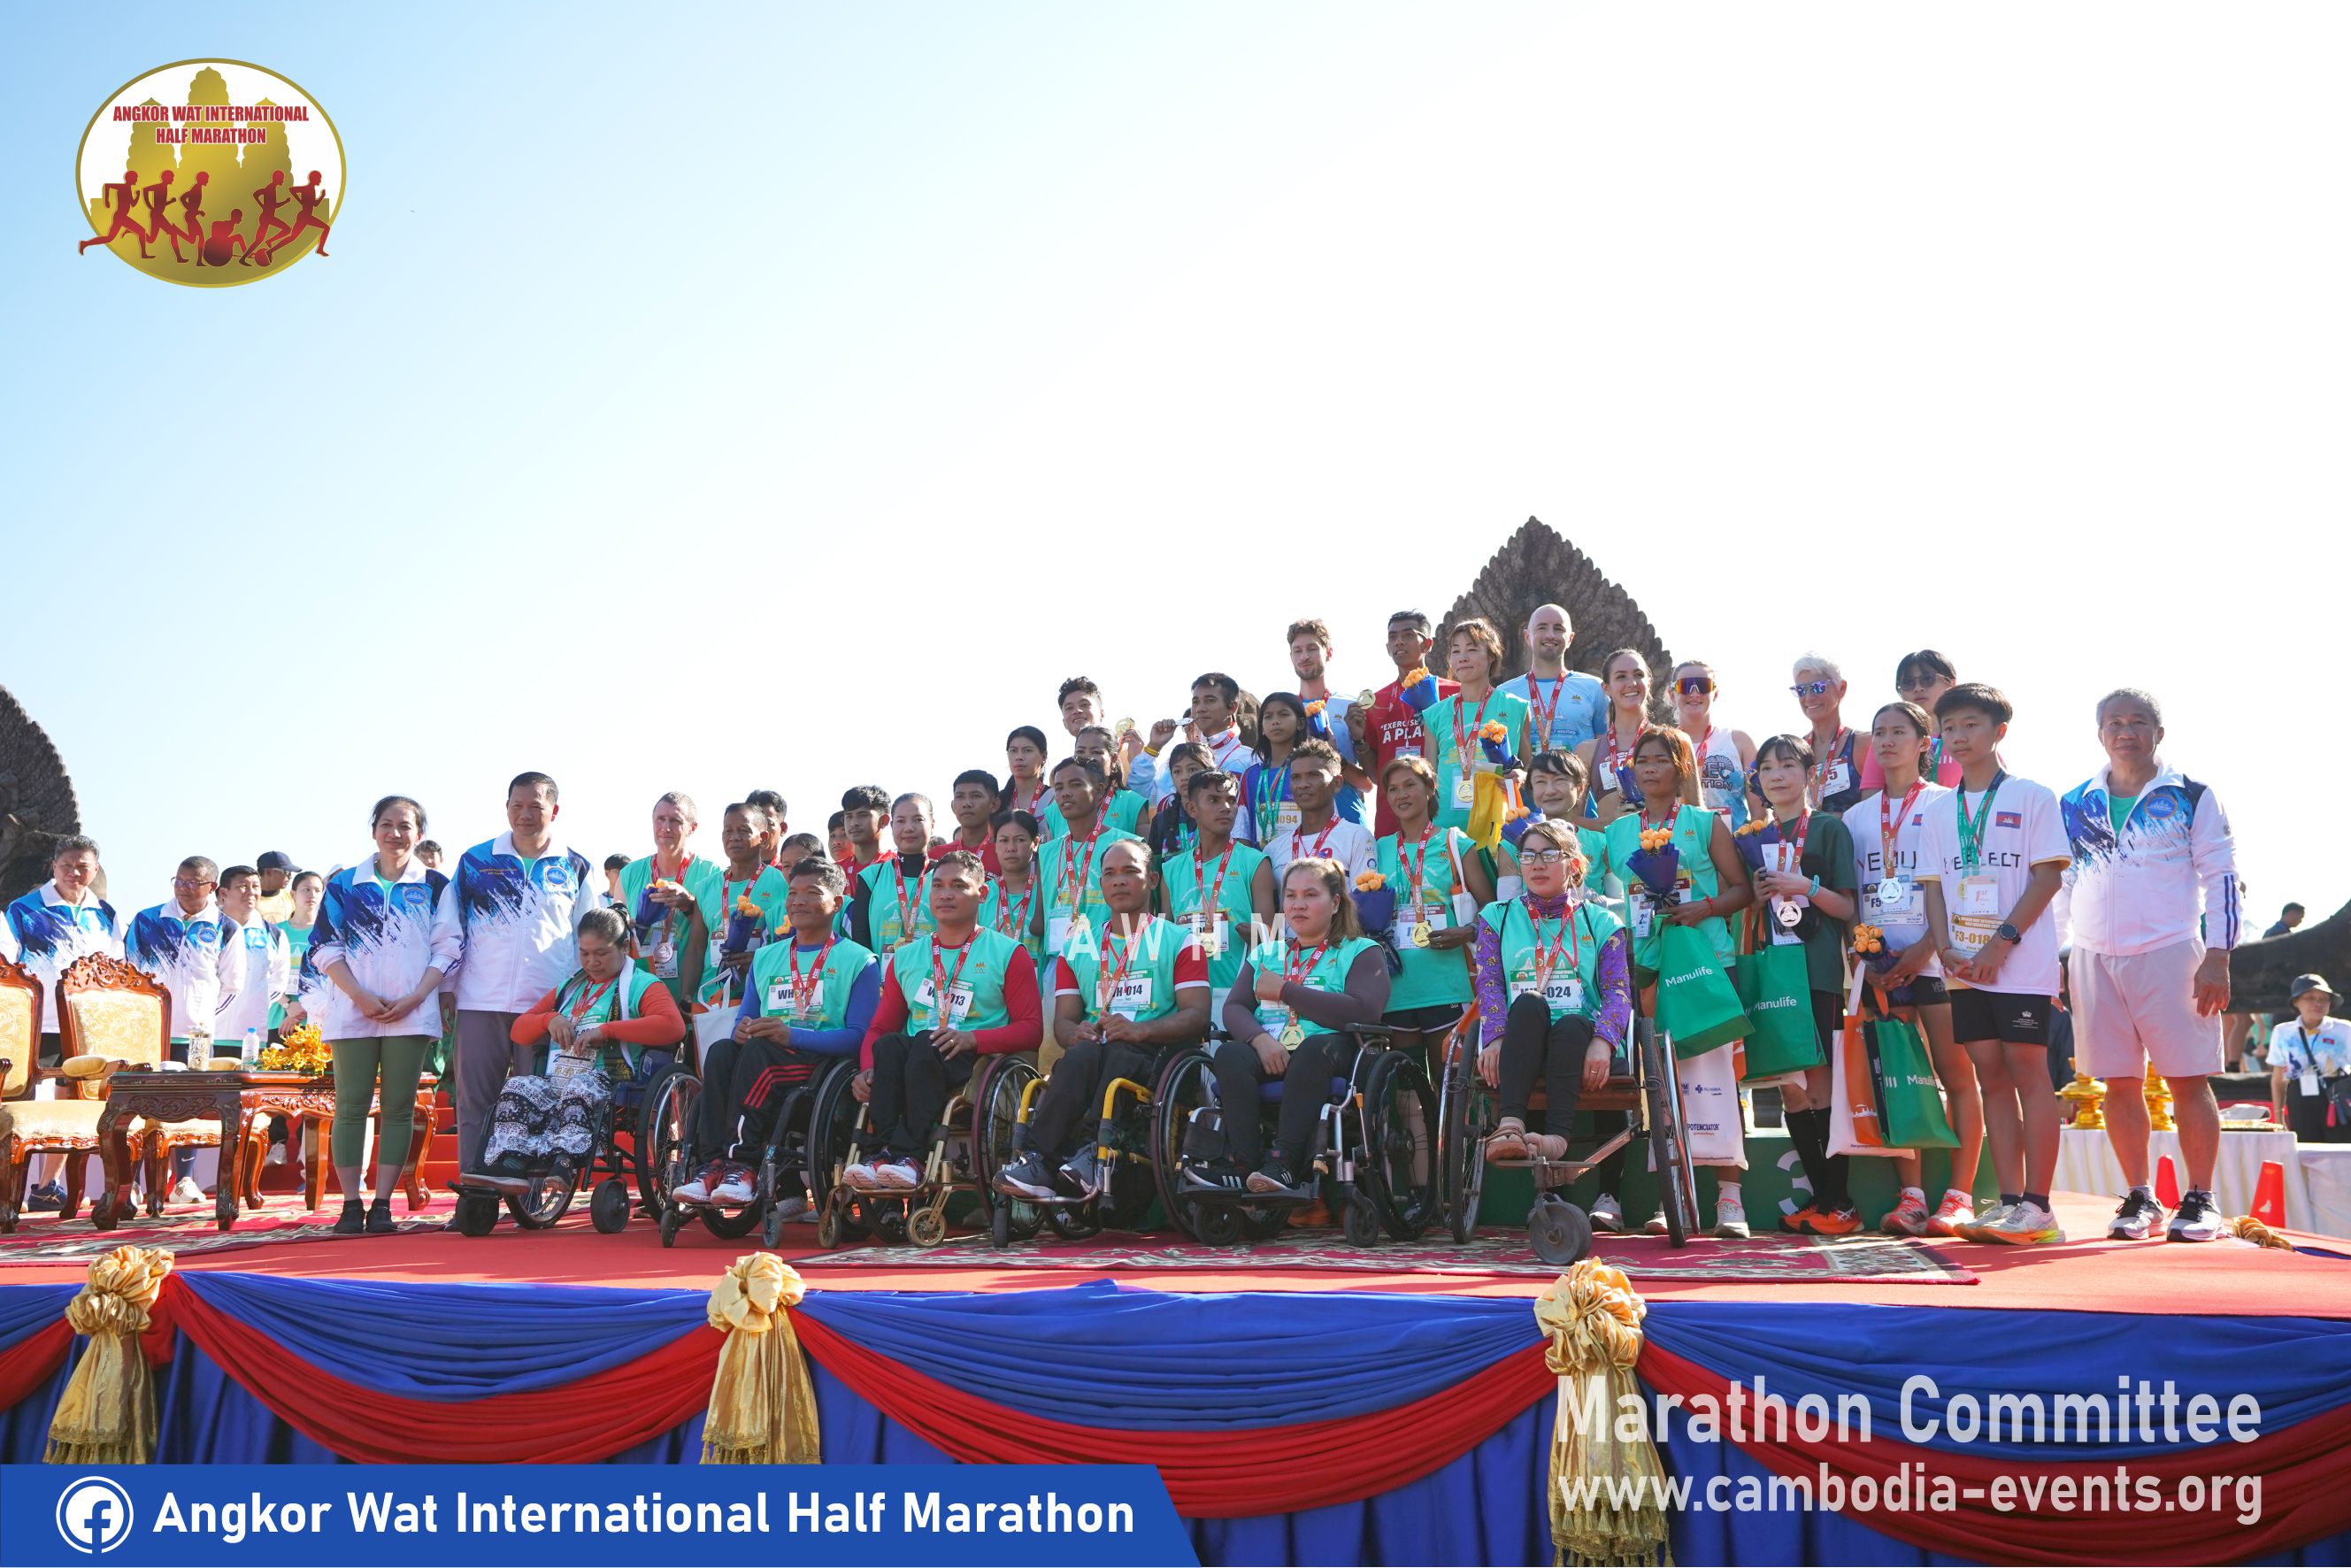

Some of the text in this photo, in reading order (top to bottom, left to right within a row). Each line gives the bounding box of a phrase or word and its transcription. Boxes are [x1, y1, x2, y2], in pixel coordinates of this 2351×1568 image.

[1394, 726, 1425, 741] PLA
[1665, 966, 1714, 988] Manulife
[1777, 1149, 1814, 1216] 3
